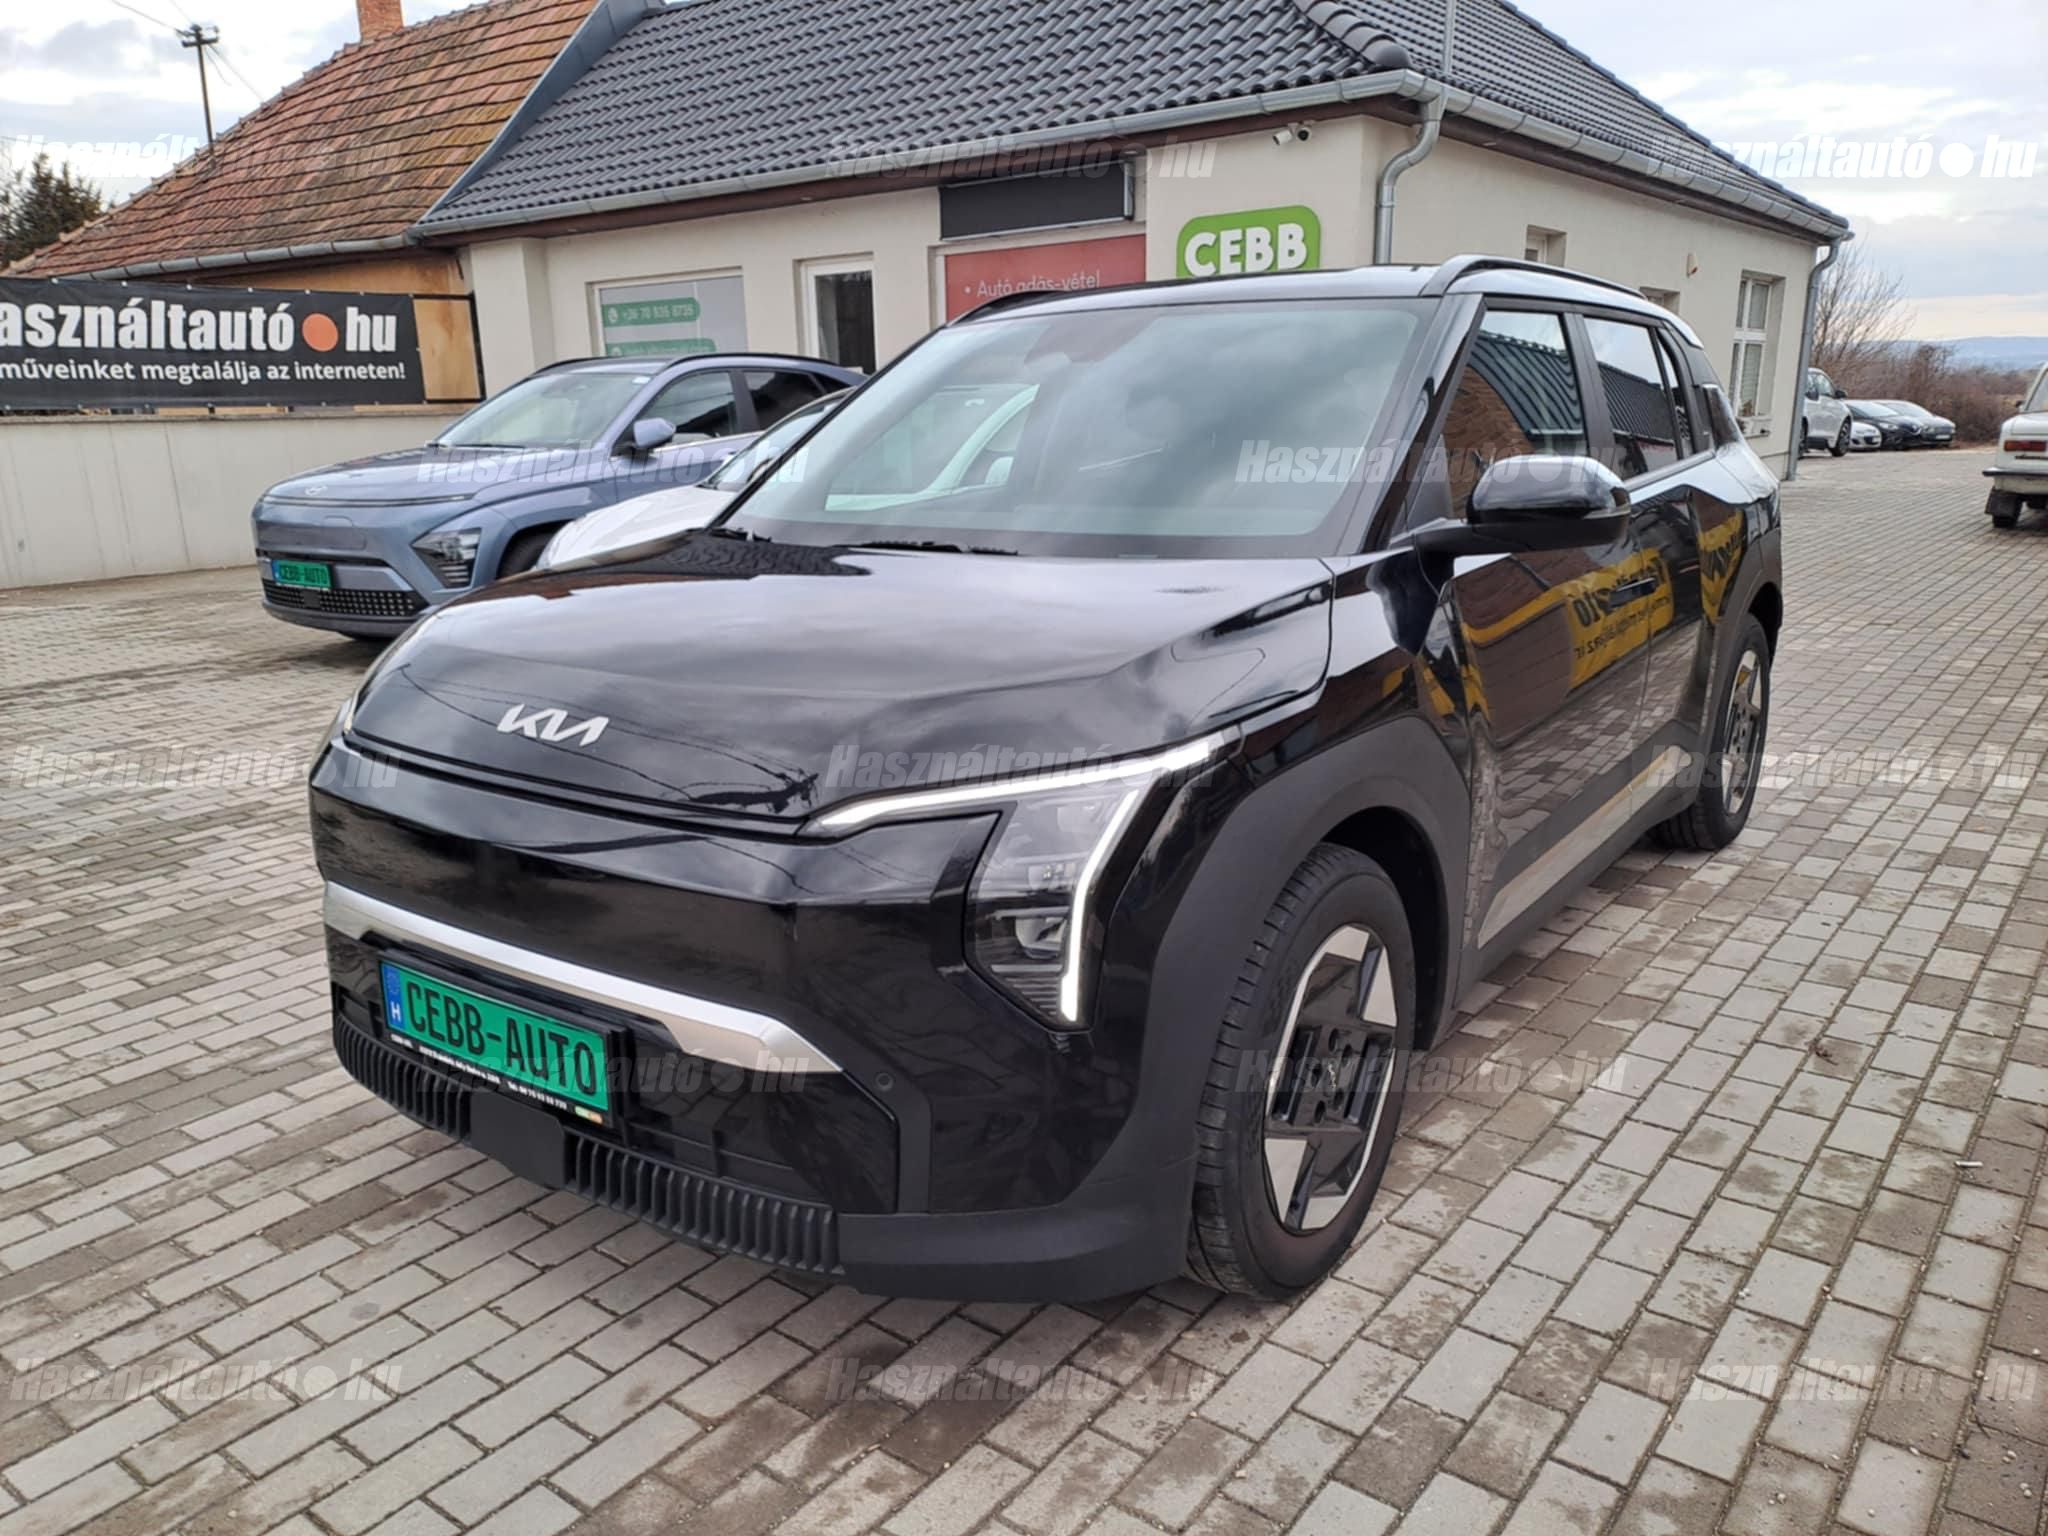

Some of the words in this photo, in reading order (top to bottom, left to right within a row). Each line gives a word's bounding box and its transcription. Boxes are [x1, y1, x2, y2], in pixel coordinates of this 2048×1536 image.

[1184, 223, 1307, 277] CEBB
[977, 279, 1012, 297] Autó
[1015, 269, 1101, 292] adás-vétel
[141, 360, 261, 385] megtalálja
[267, 364, 291, 380] az
[294, 361, 406, 380] interneten!
[497, 703, 609, 747] KIA
[406, 982, 597, 1097] CEBB-AUTO
